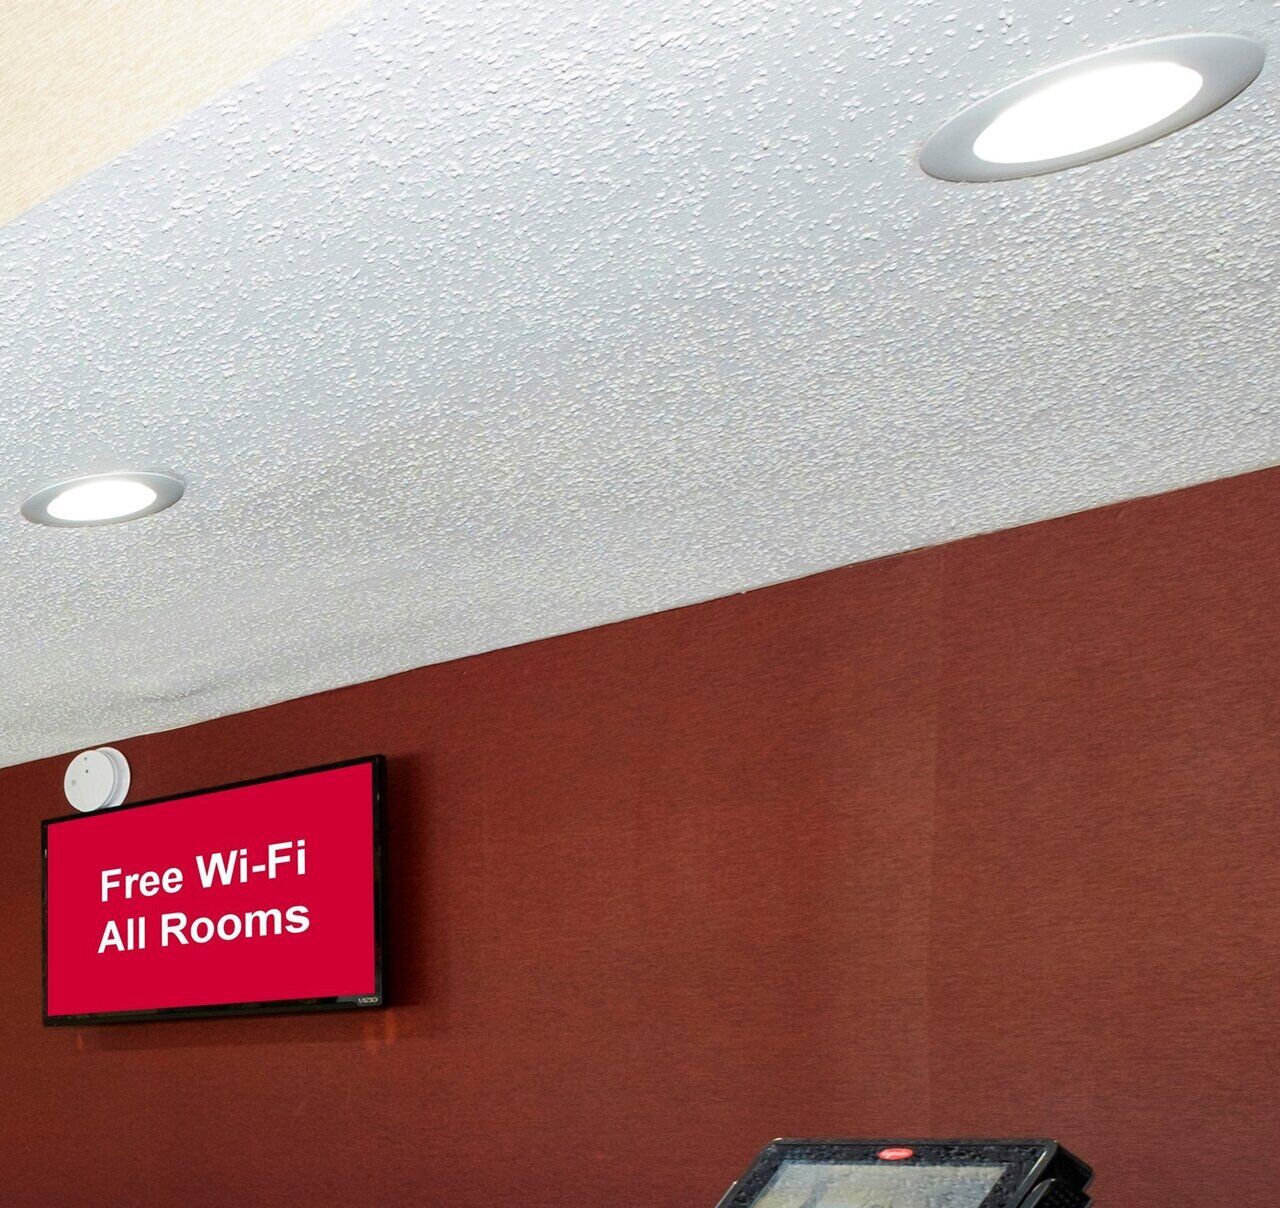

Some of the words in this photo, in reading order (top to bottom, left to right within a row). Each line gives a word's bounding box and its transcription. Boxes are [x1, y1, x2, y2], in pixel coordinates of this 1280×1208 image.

[100, 867, 183, 902] Free
[196, 839, 306, 888] Wi-Fi
[97, 917, 145, 953] All
[160, 904, 310, 947] Rooms
